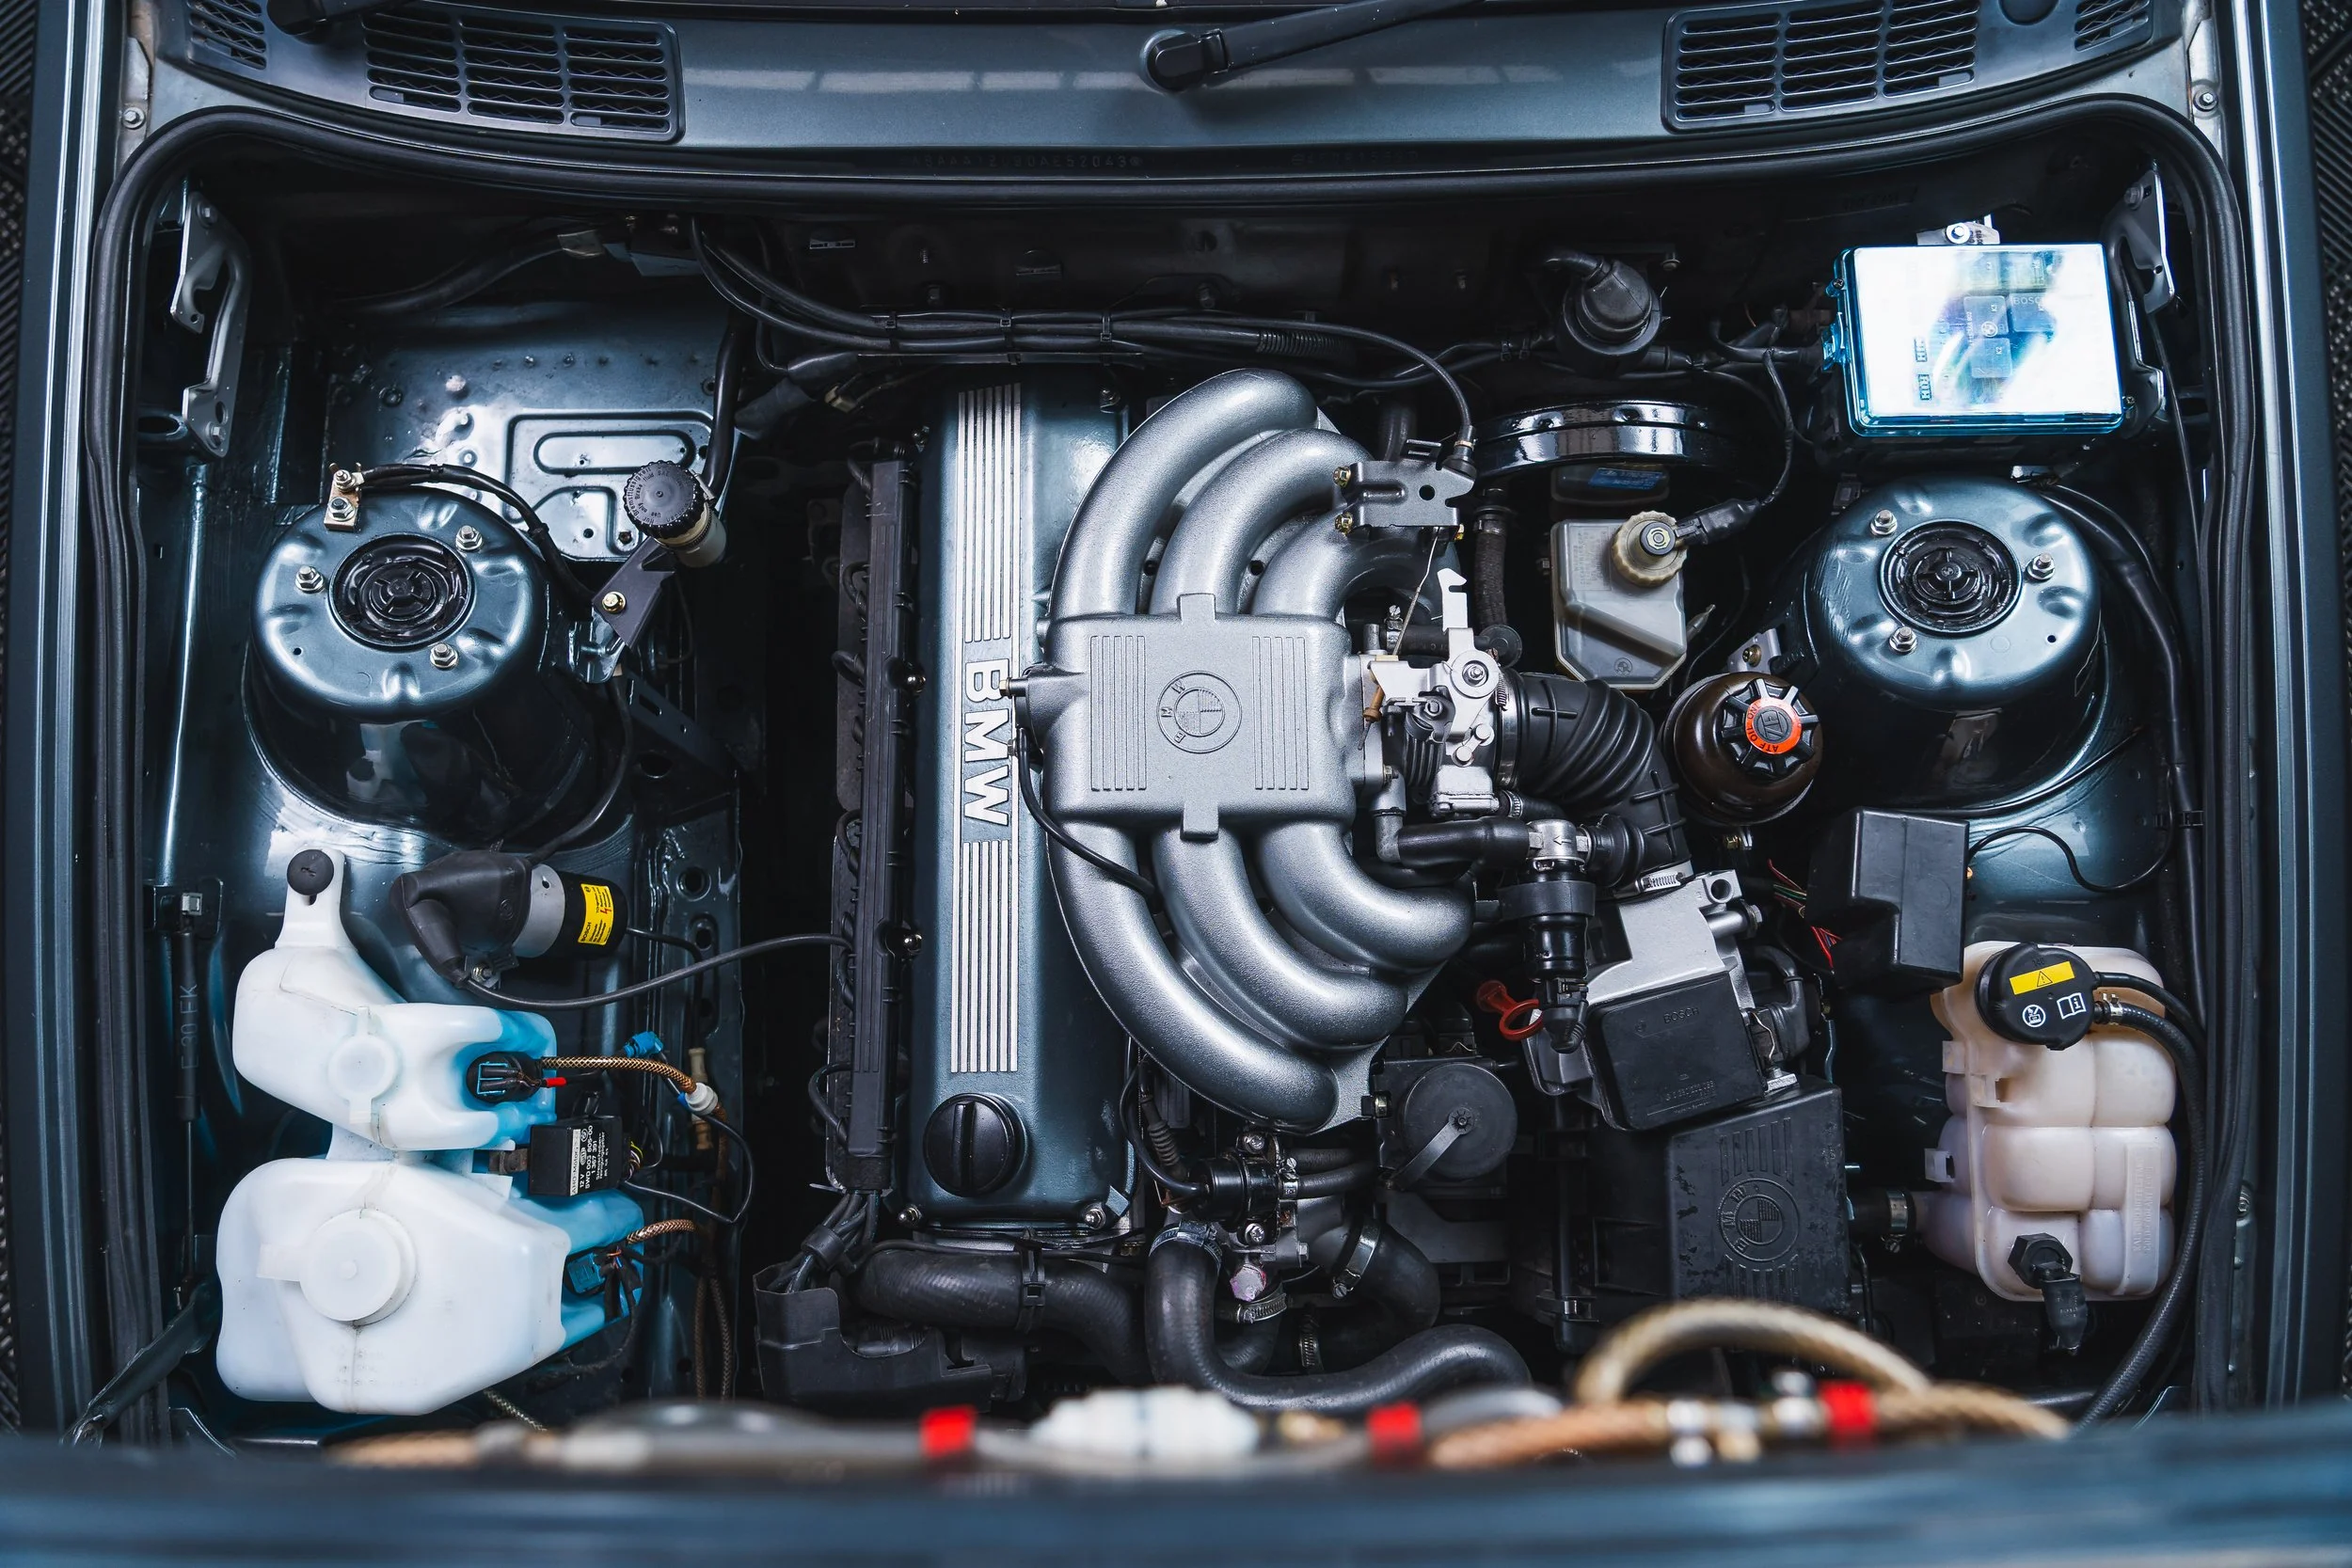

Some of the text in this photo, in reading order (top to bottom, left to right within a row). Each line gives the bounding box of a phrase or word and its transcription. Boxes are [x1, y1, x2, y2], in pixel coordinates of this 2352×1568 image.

[2013, 296, 2044, 305] BOSC
[1745, 700, 1779, 752] ATF OIL ONL
[964, 659, 1010, 827] BMW
[179, 984, 199, 1014] FK
[1662, 1006, 1700, 1024] BOSCH
[580, 1180, 585, 1189] 12
